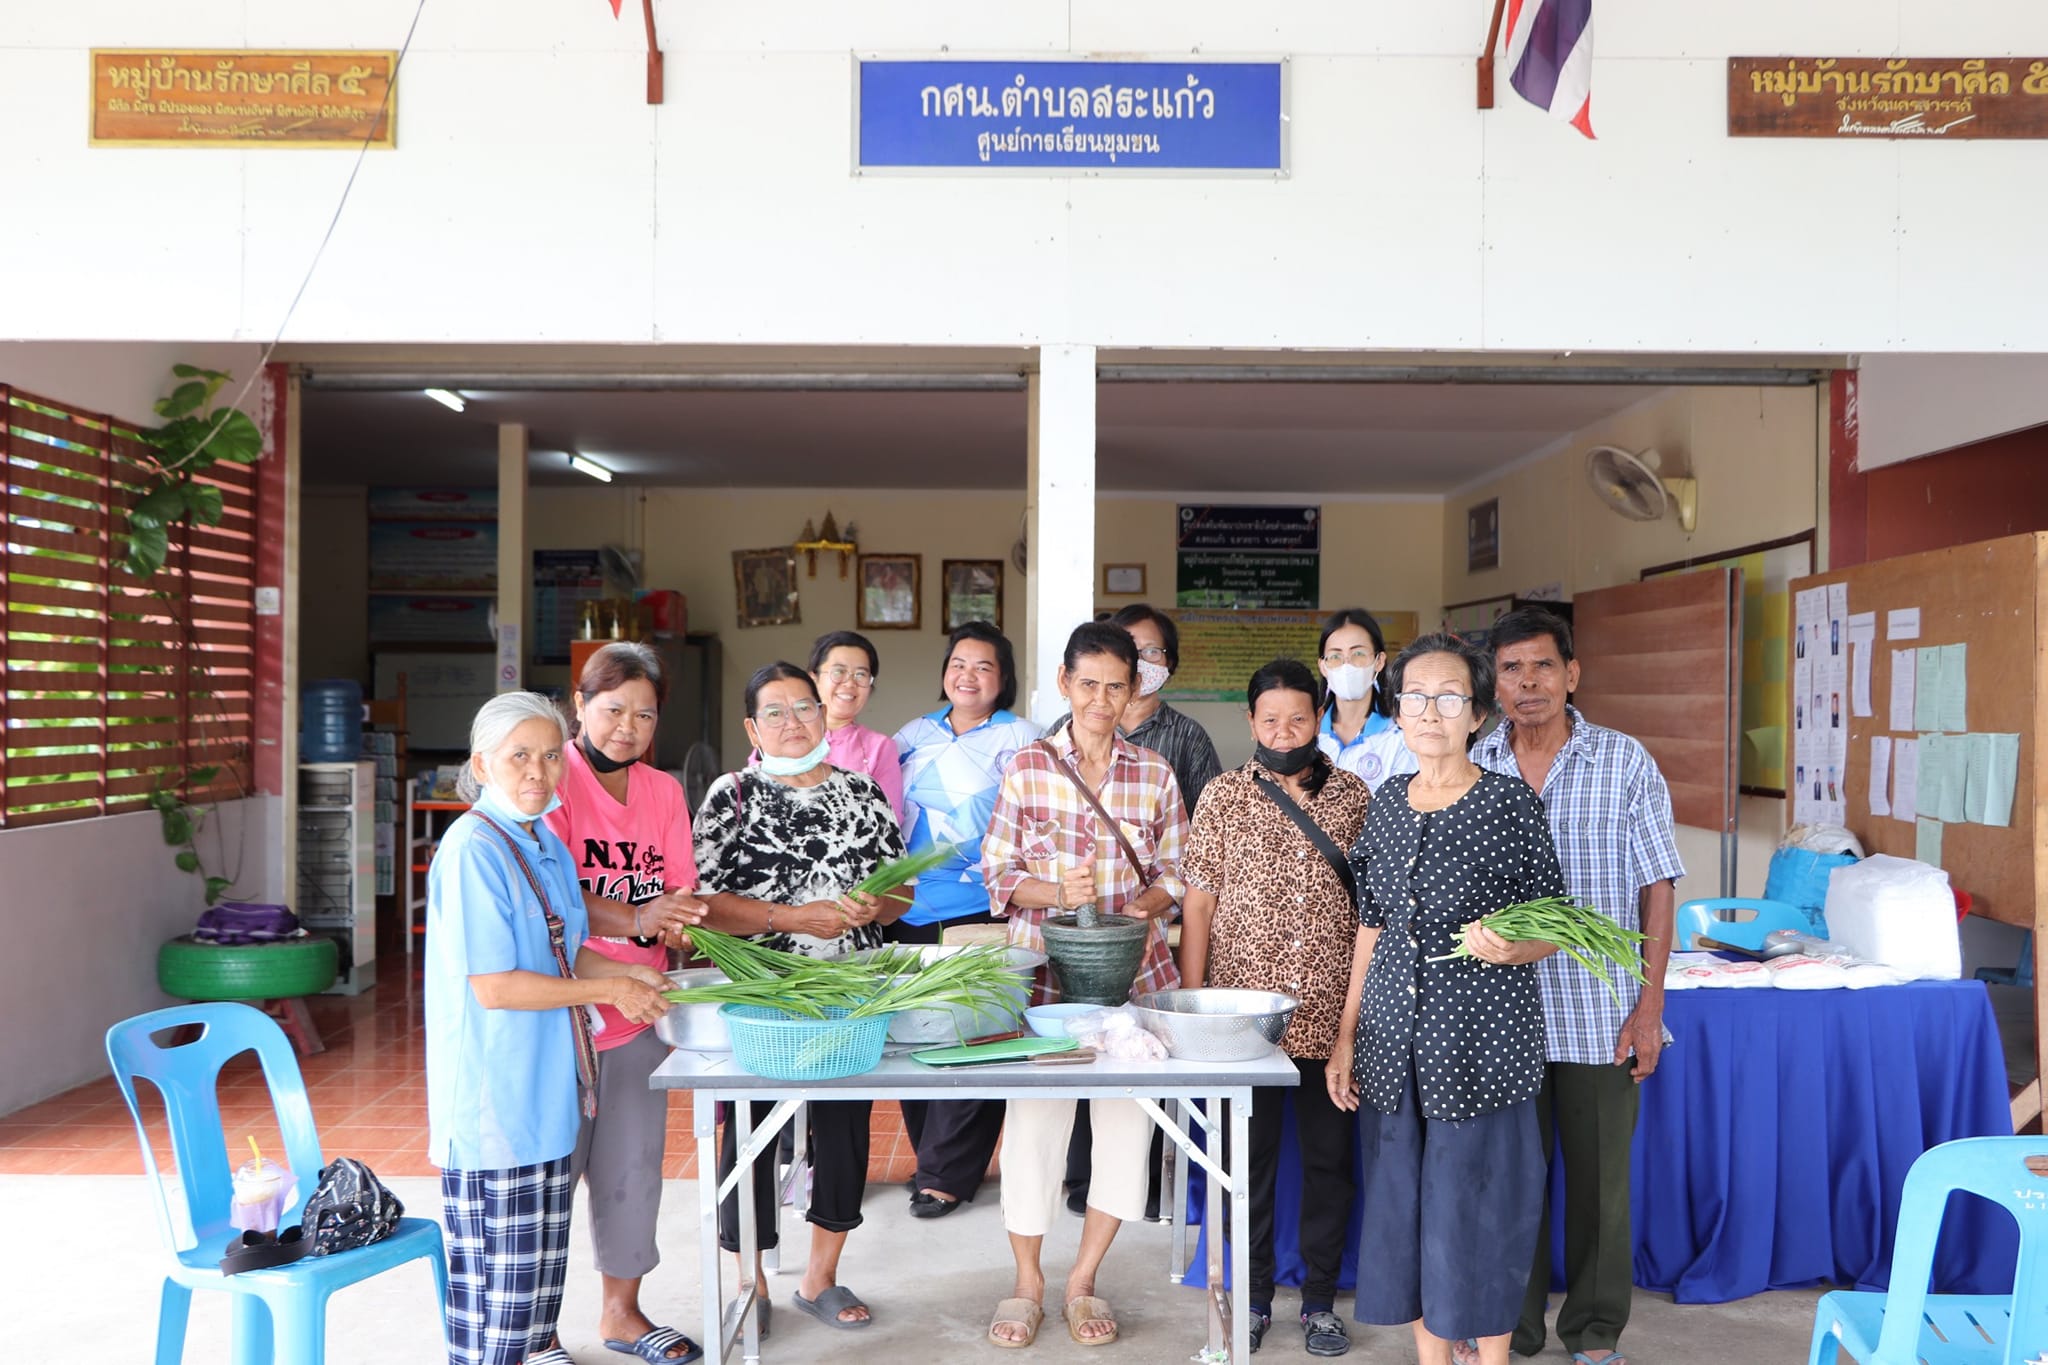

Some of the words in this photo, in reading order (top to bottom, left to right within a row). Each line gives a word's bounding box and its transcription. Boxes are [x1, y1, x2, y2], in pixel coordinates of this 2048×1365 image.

[109, 57, 331, 99] หมู่บ้านรักษาศีล
[337, 65, 372, 96] ๕
[920, 73, 1216, 119] กศน.ตำบลสระแก้ว
[1750, 58, 2010, 106] หมู่บ้านรักษาศีล
[977, 126, 1160, 162] ศูนย์การเรียนชุมชน
